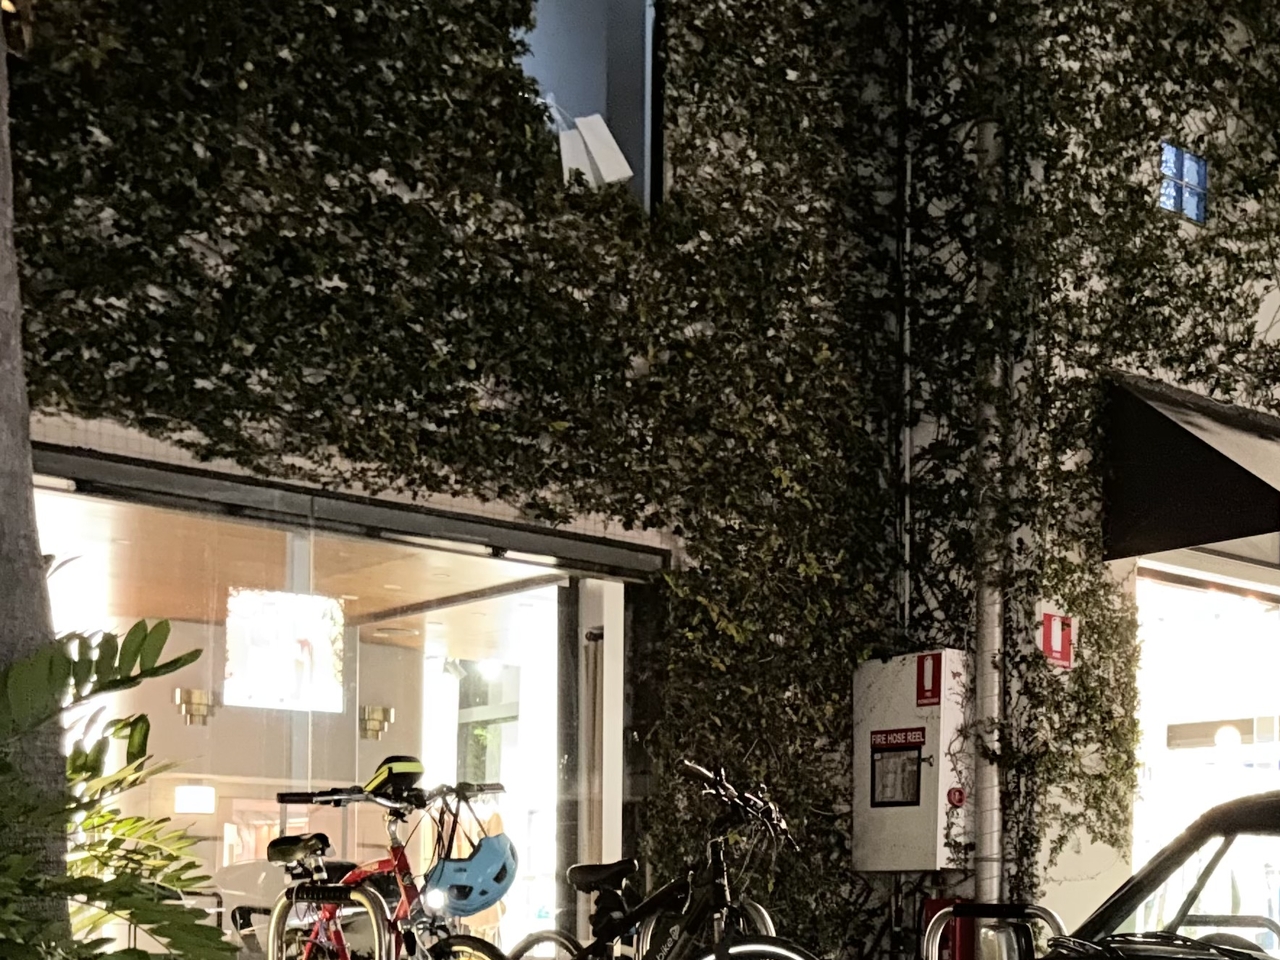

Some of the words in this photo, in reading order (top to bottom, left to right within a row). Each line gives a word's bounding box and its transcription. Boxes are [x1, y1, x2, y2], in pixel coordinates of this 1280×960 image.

[872, 734, 886, 744] FIRE
[888, 733, 905, 743] HOSE
[907, 732, 924, 742] REEL
